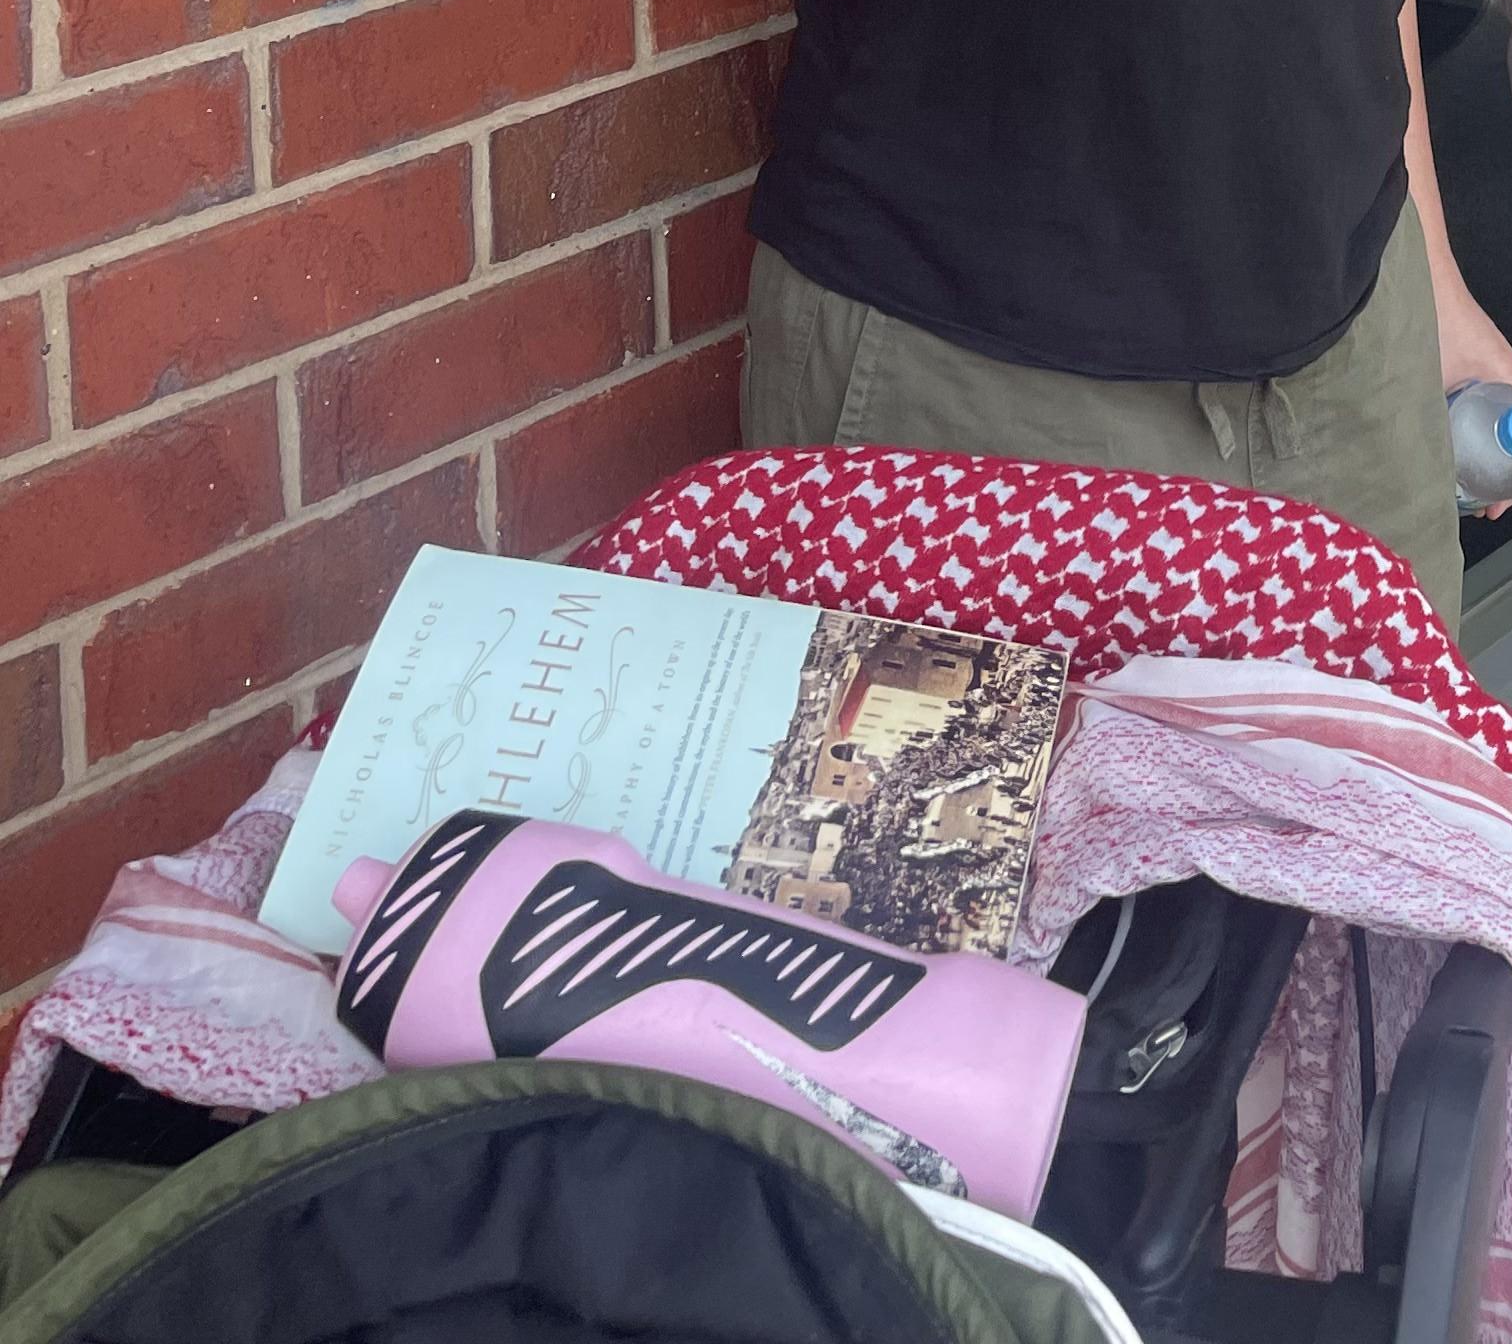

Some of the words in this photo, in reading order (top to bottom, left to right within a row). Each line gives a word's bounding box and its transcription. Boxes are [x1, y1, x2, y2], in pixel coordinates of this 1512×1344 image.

[656, 638, 686, 691] TOWN
[326, 713, 390, 859] NICHOLAS
[388, 598, 444, 705] BLINCOE
[478, 591, 602, 812] HLEHEM
[650, 702, 664, 711] A
[637, 724, 657, 749] OF
[610, 762, 644, 834] RAPHY
